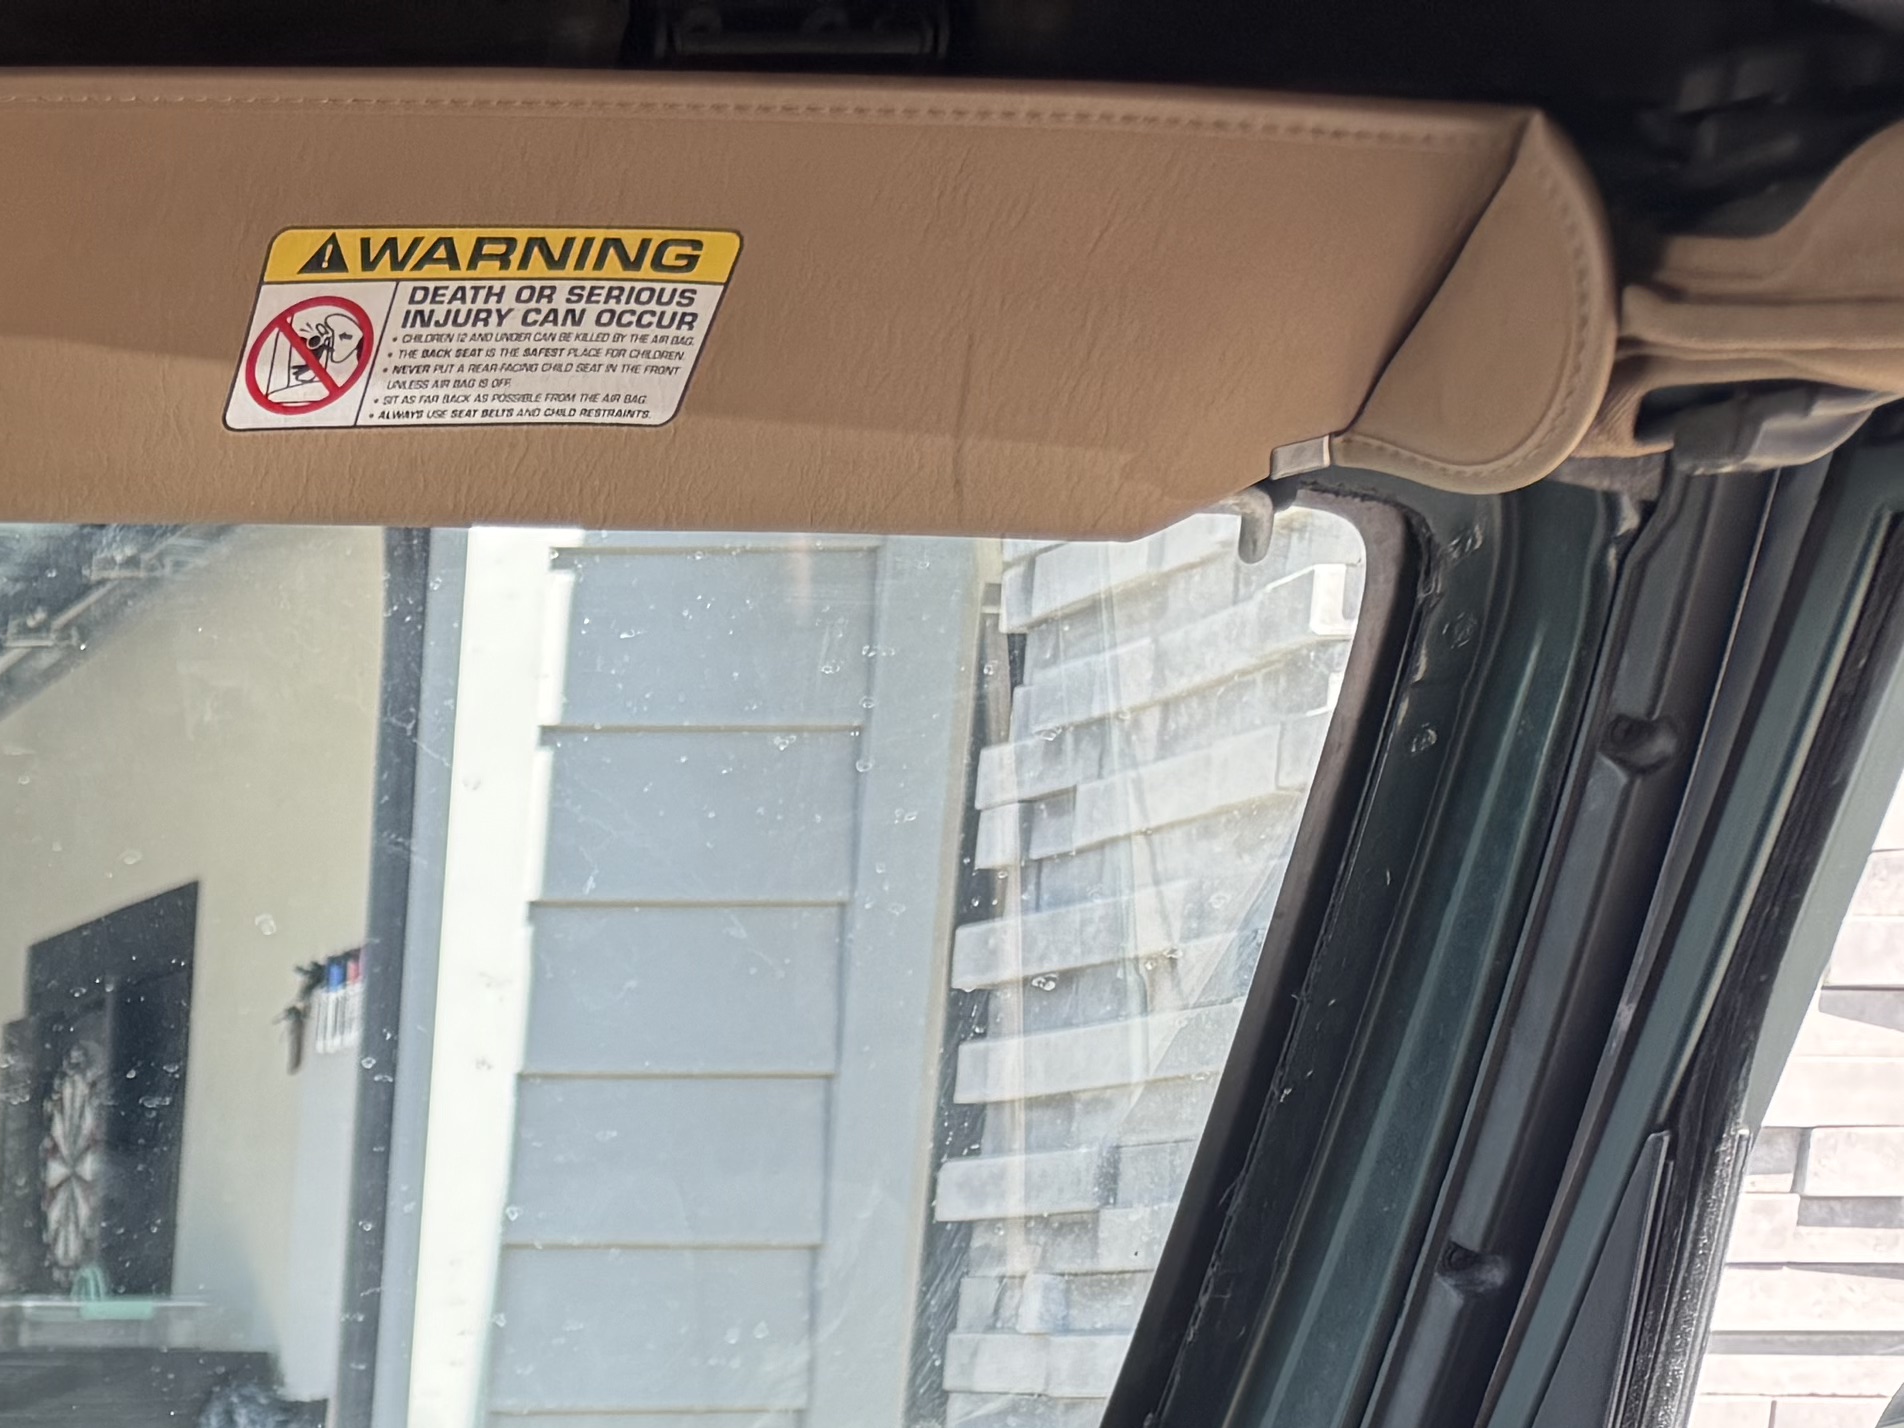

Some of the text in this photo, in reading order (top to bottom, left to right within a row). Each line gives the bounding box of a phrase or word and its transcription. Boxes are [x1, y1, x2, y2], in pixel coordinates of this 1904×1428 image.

[359, 237, 704, 273] WARNING
[407, 285, 700, 305] DEATH OR SERIOUS
[400, 308, 701, 328] INJURY CAN OCCUR
[397, 348, 419, 358] THE
[420, 348, 452, 358] BACK
[453, 348, 483, 358] SEAT
[484, 348, 497, 358] IS
[497, 348, 520, 358] THE
[521, 348, 565, 358] SAFEST
[565, 348, 602, 358] PLACE
[603, 348, 627, 359] FOR
[391, 363, 431, 373] NEVER
[432, 363, 454, 374] PUT
[455, 364, 466, 374] A
[539, 364, 573, 374] CHILD
[574, 364, 602, 374] SEAT
[603, 364, 618, 374] IN
[618, 364, 642, 374] THE
[642, 364, 682, 375] FRONT
[377, 408, 424, 417] ALWAYS
[426, 408, 448, 417] USE
[450, 409, 478, 418] SEAT
[479, 409, 514, 418] BELTS
[515, 409, 541, 418] AND
[542, 409, 577, 418] CHILD
